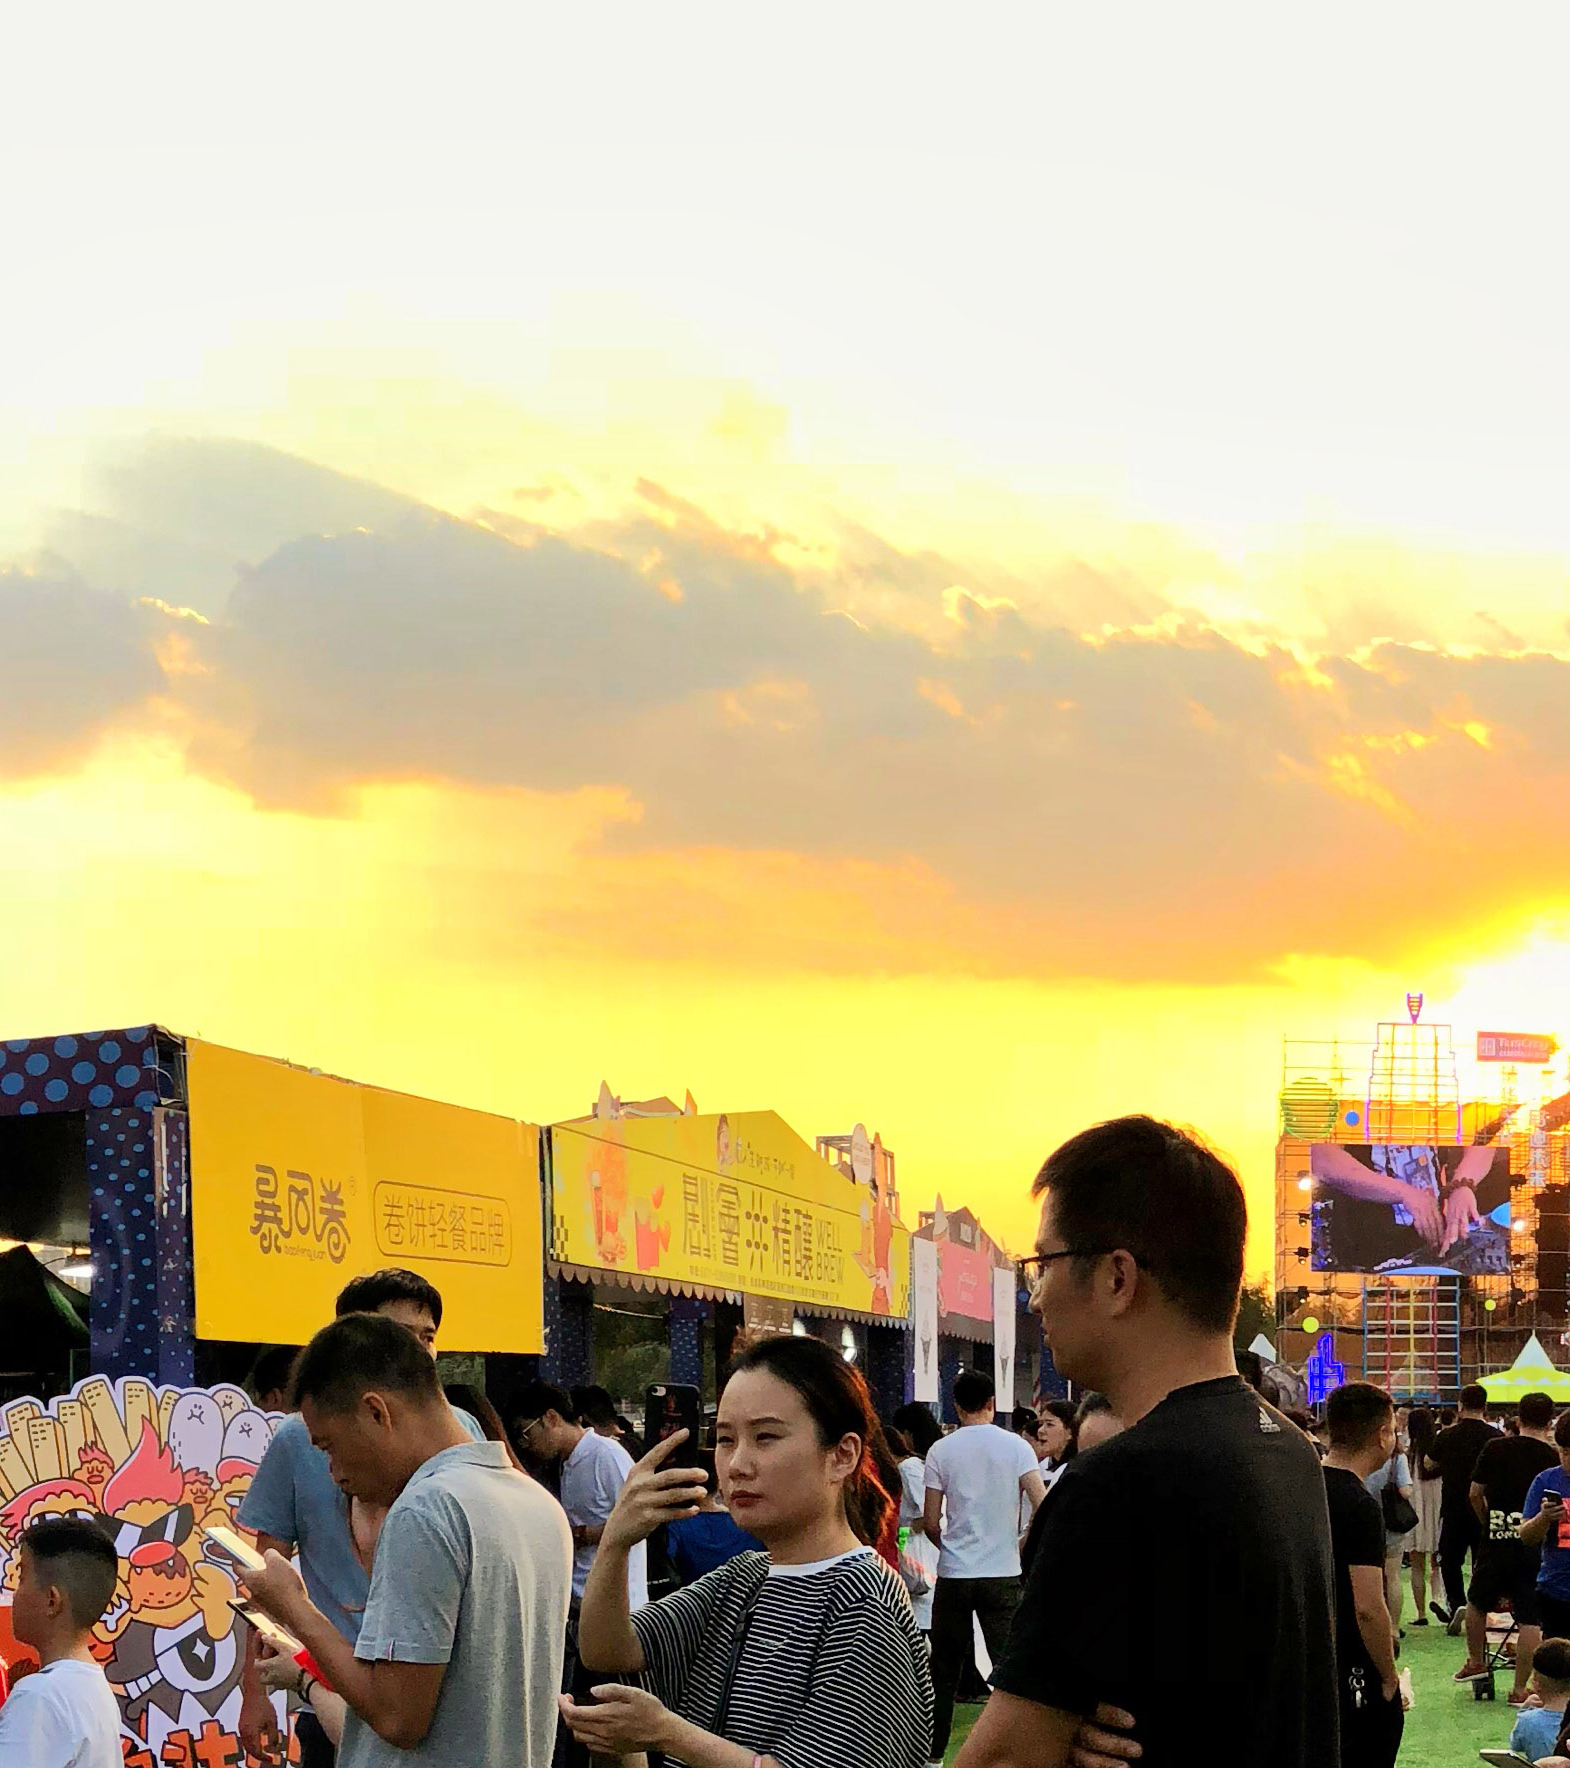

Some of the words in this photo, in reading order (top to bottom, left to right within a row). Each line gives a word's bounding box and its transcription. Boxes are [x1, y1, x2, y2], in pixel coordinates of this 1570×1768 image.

[383, 1194, 506, 1257] 卷饼轻餐品牌
[816, 1218, 843, 1253] WELL
[817, 1251, 844, 1285] BREW
